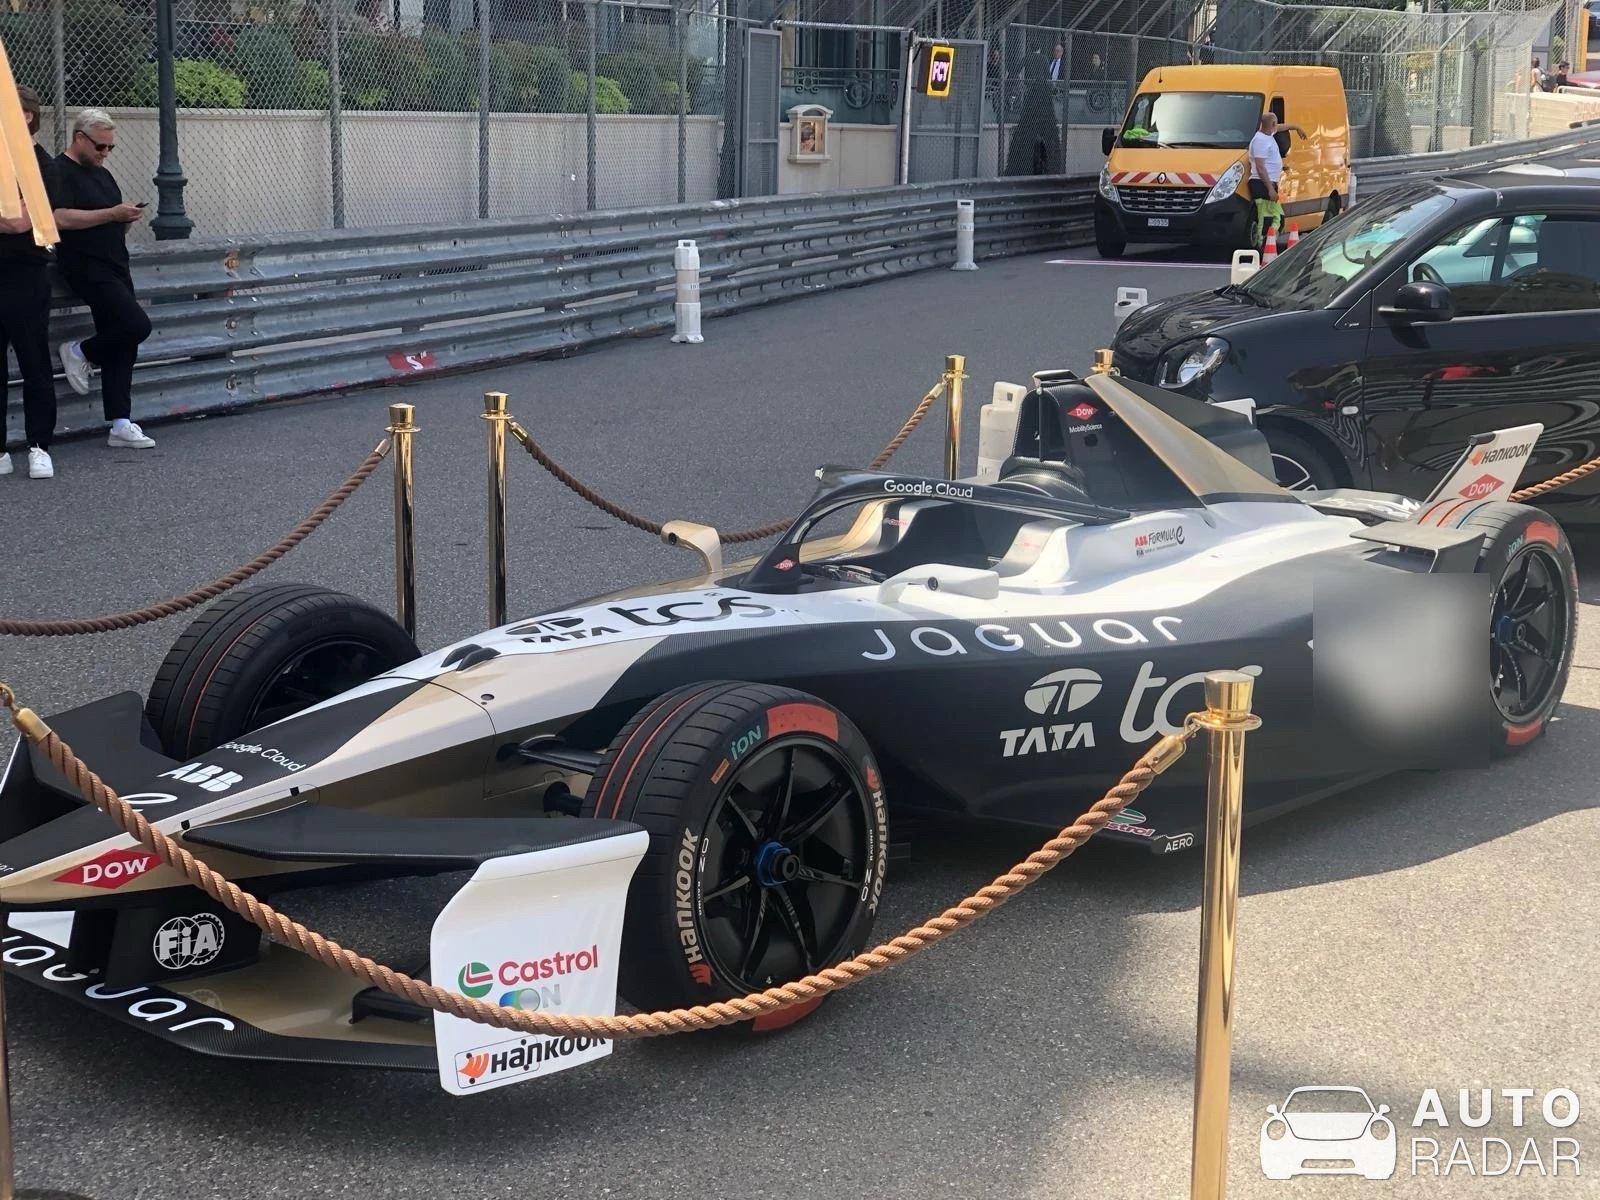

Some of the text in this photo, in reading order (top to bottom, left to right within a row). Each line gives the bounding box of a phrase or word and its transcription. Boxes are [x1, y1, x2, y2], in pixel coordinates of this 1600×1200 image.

[883, 479, 974, 498] Google Cloud
[1468, 480, 1497, 497] DOW
[608, 596, 776, 627] tcs
[519, 626, 623, 643] TATA
[1119, 660, 1263, 744] tc
[1000, 721, 1097, 758] TATA
[260, 748, 307, 772] Cloud
[156, 762, 244, 792] ABB
[1164, 835, 1194, 852] AERO
[82, 856, 150, 884] DOW
[498, 944, 599, 987] Castrol
